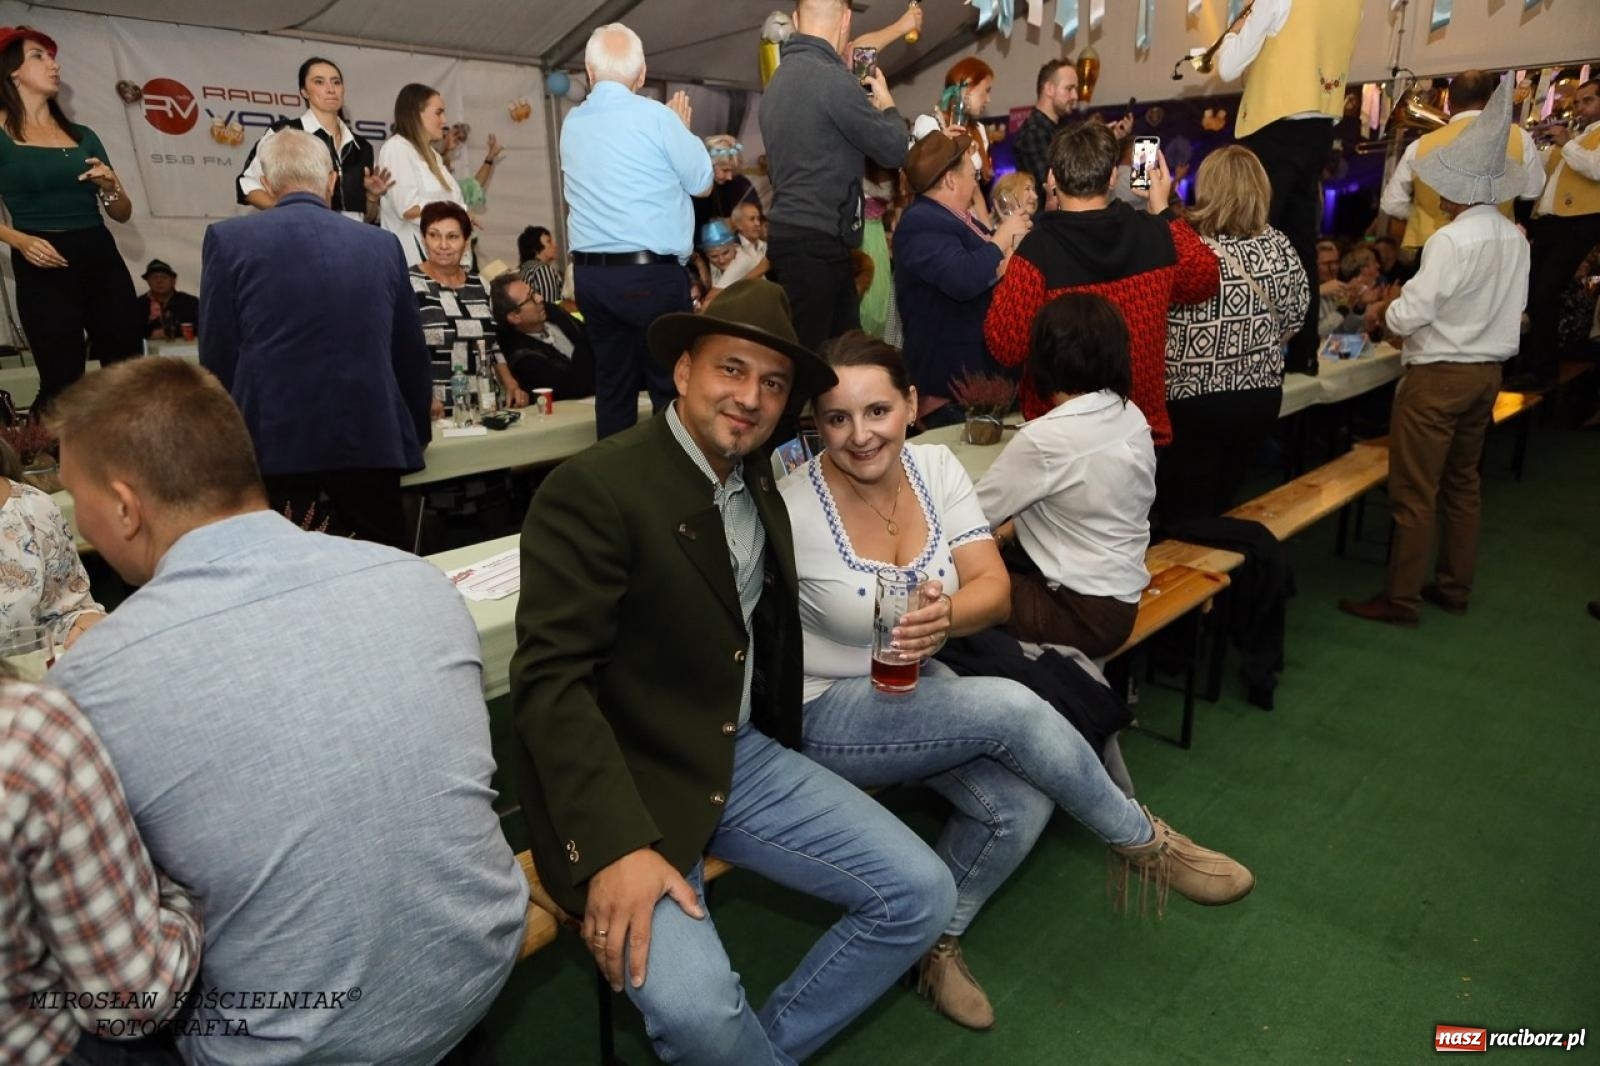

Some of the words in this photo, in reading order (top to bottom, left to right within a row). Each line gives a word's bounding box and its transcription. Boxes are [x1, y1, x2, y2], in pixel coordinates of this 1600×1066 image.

[202, 86, 301, 106] RADIO
[150, 153, 195, 165] 95.8
[203, 156, 232, 167] FM
